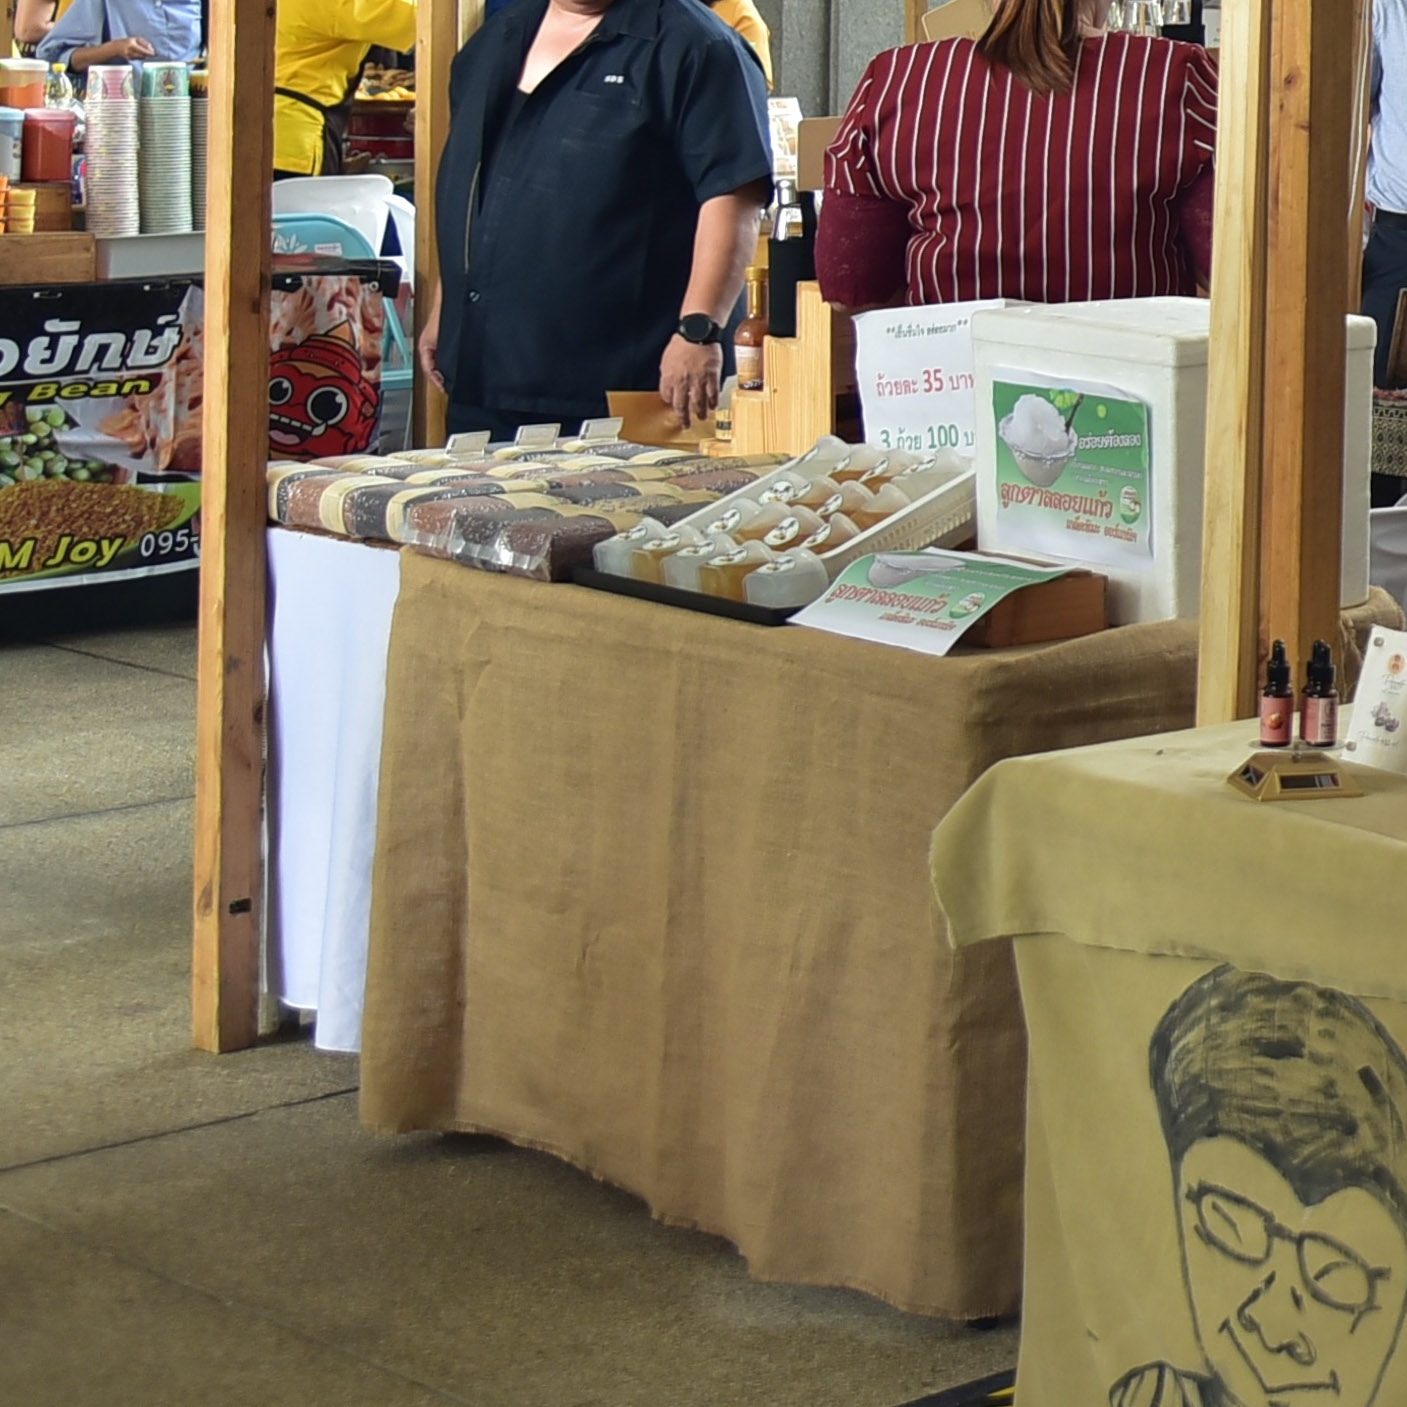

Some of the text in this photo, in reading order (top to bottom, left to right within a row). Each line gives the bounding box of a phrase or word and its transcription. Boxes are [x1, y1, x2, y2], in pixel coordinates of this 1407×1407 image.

[27, 378, 151, 401] Bean
[876, 372, 919, 398] ถ้วยละ
[922, 368, 945, 393] 35
[880, 429, 892, 449] 3
[896, 426, 922, 451] ถ้วย
[926, 423, 960, 450] 100
[1000, 482, 1114, 519] ลูกตาลลอยแก้ว
[45, 535, 125, 568] Joy
